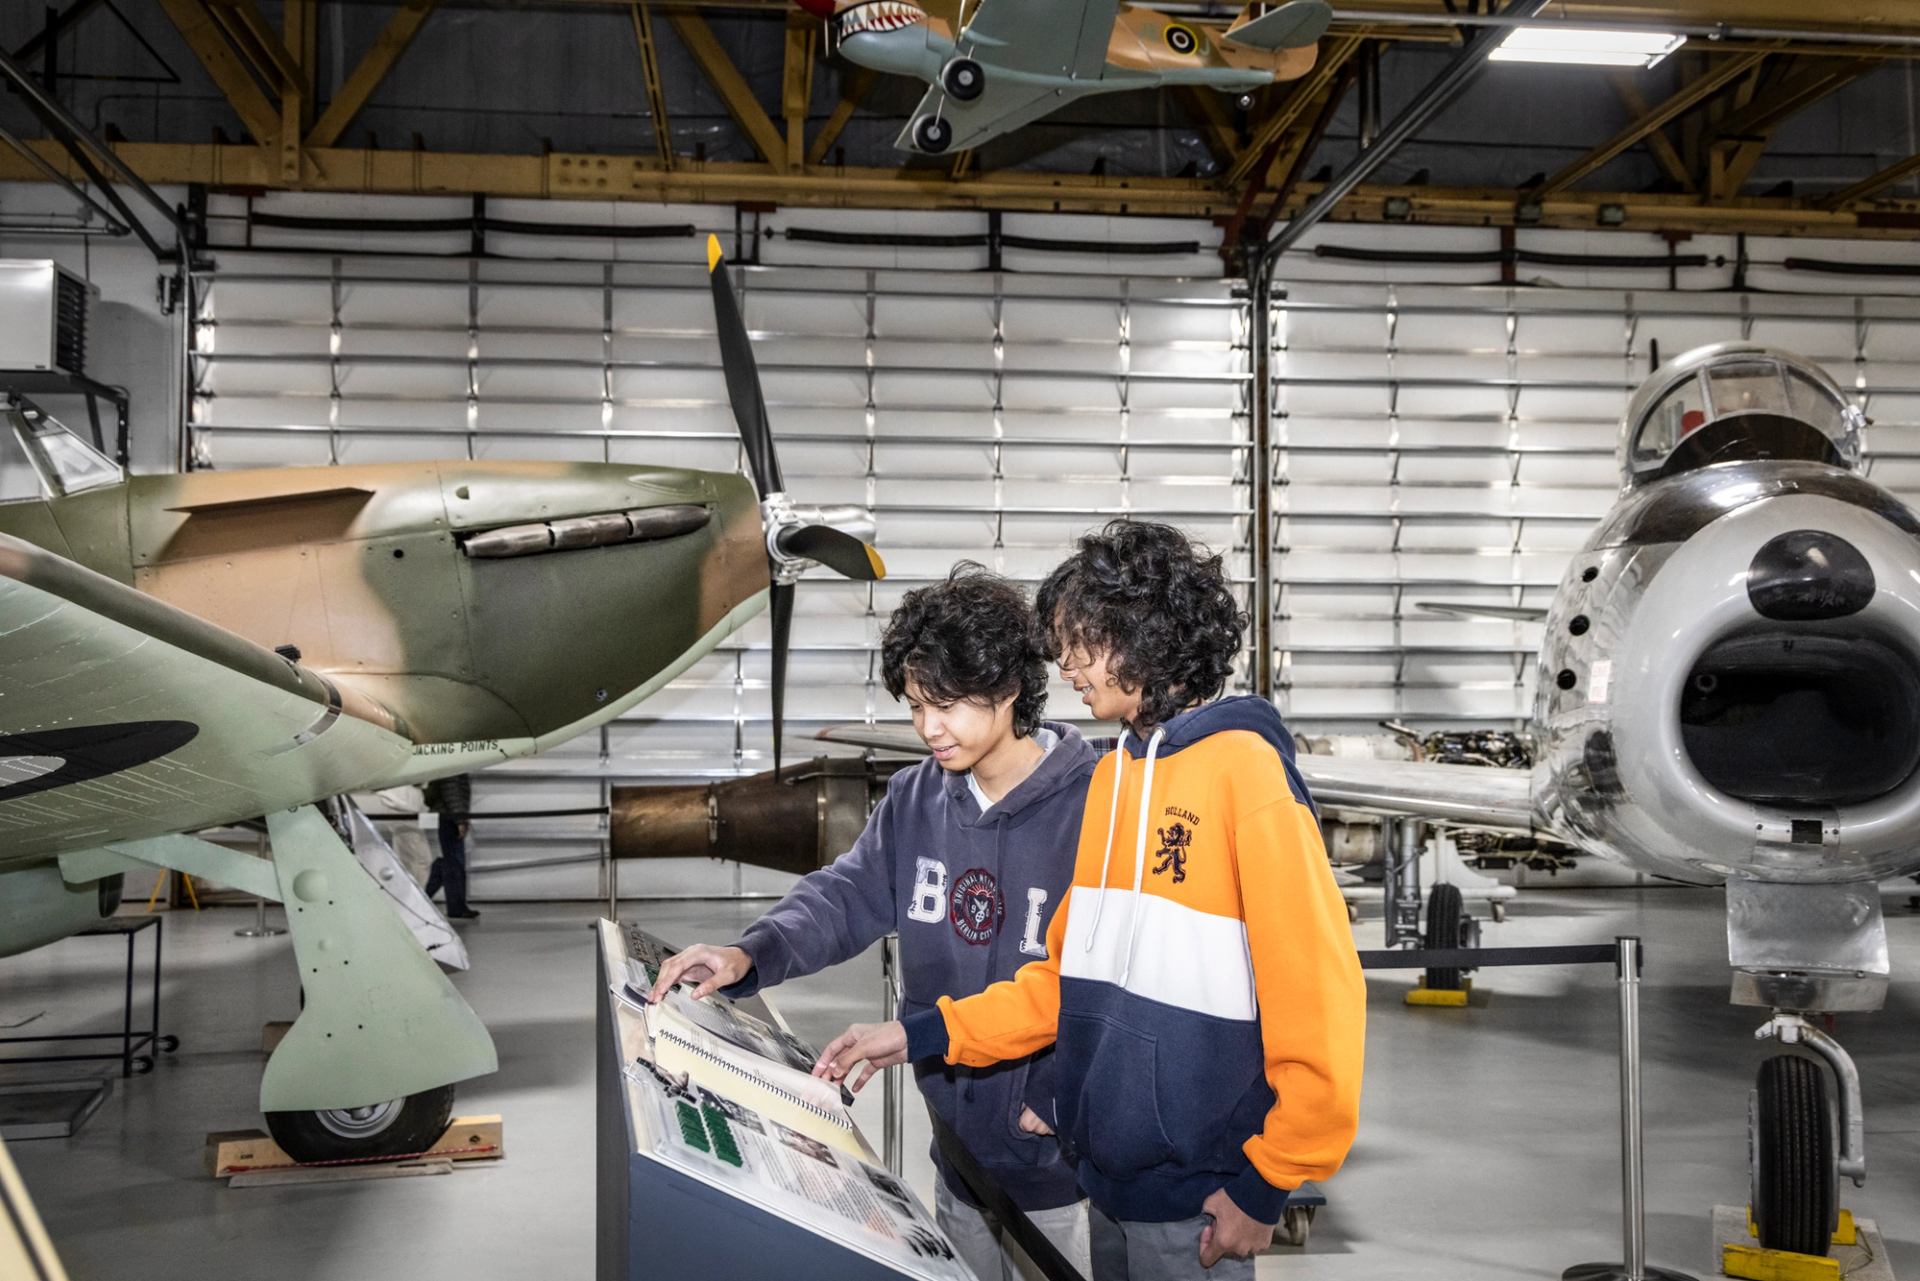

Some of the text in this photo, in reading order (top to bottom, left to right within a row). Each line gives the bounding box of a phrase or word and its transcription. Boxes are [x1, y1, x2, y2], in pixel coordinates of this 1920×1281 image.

[412, 740, 498, 755] JACKING POINTS
[1165, 806, 1200, 826] HOLLAND
[907, 856, 947, 924] B
[954, 874, 977, 904] ORIGINAL
[956, 918, 993, 941] BERLIN CITY
